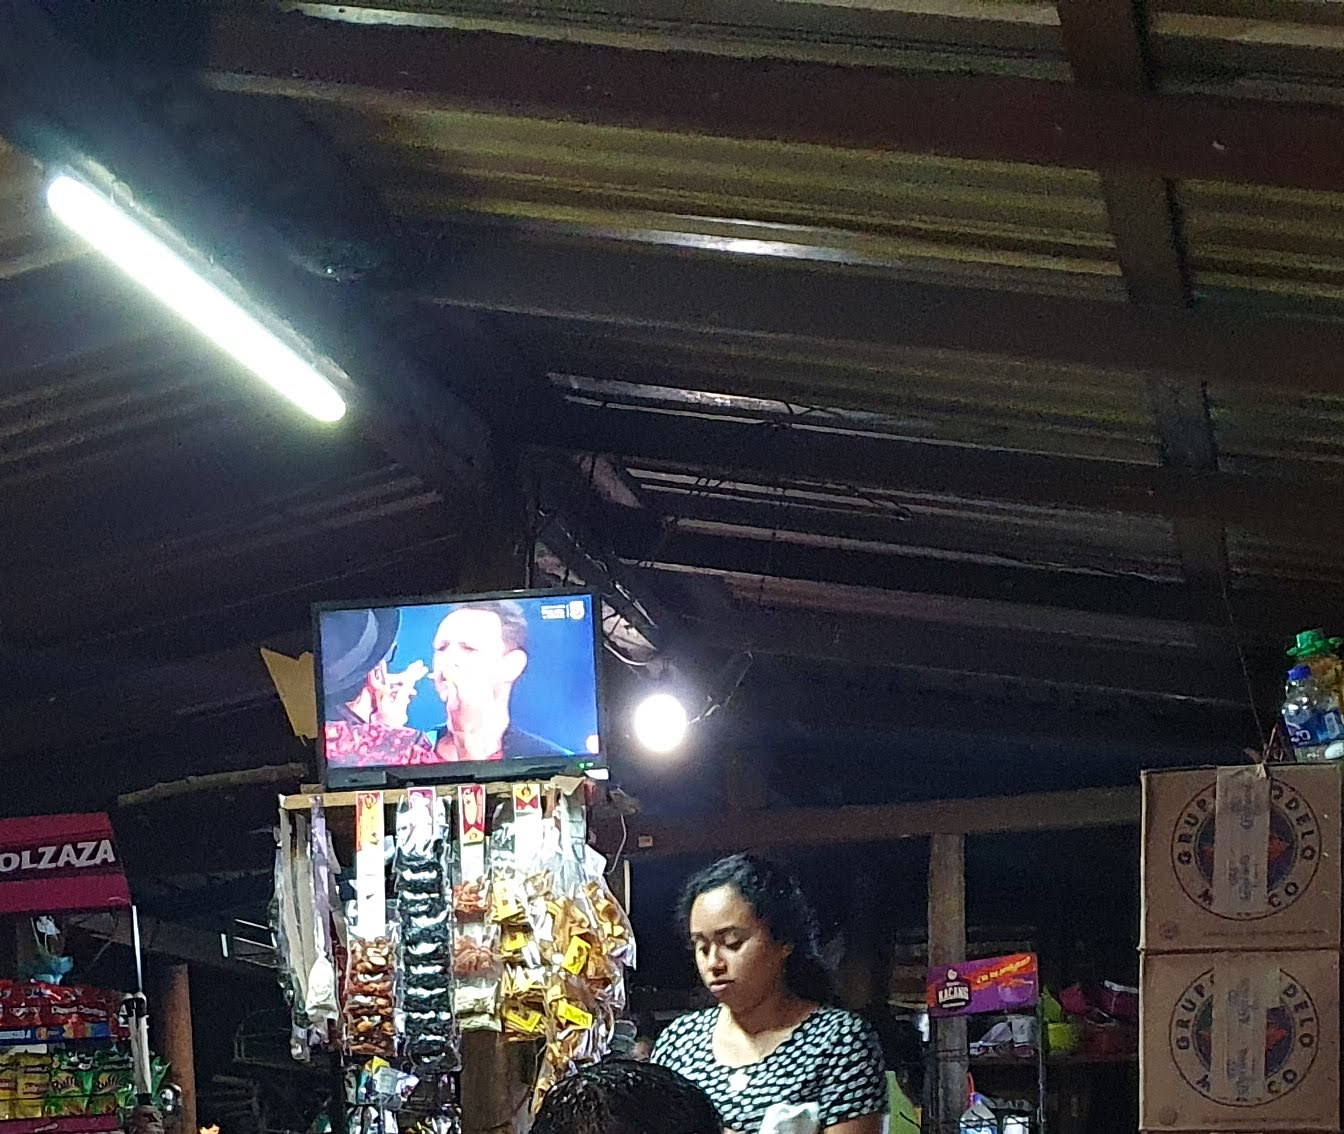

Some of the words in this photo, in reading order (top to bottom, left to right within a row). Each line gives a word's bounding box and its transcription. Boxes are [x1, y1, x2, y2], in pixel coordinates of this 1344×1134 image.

[1177, 783, 1217, 865] GRUP
[1271, 784, 1316, 862] ODELO
[1176, 973, 1215, 1050] GRUP
[1283, 983, 1315, 1048] DELO
